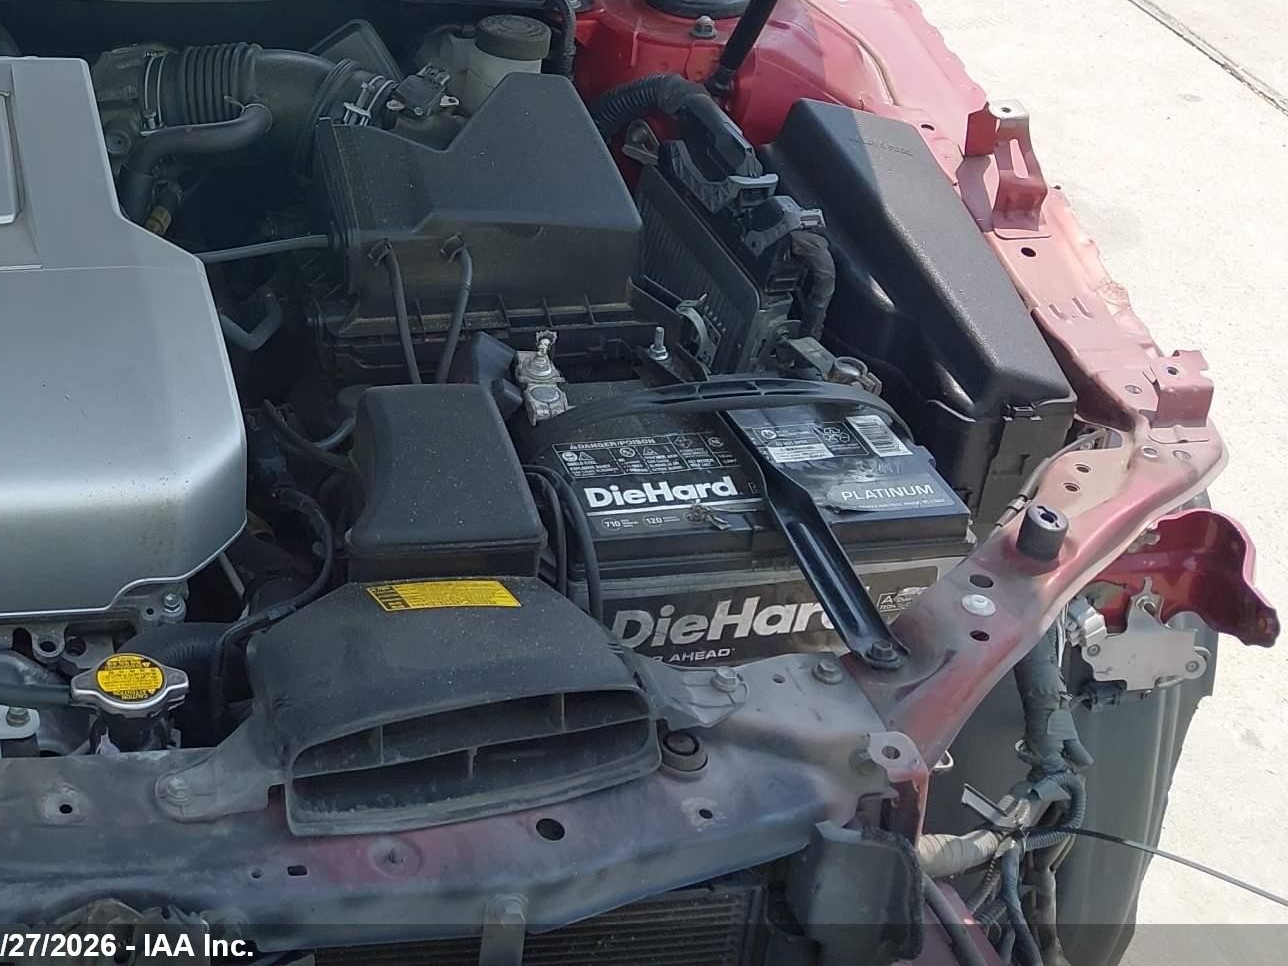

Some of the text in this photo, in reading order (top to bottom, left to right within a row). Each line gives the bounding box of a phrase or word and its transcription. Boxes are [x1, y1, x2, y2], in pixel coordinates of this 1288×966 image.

[584, 476, 739, 508] DieHard
[841, 483, 934, 501] PLATINUM
[604, 520, 621, 529] 710
[646, 516, 663, 525] 120
[670, 648, 731, 662] AHEAD
